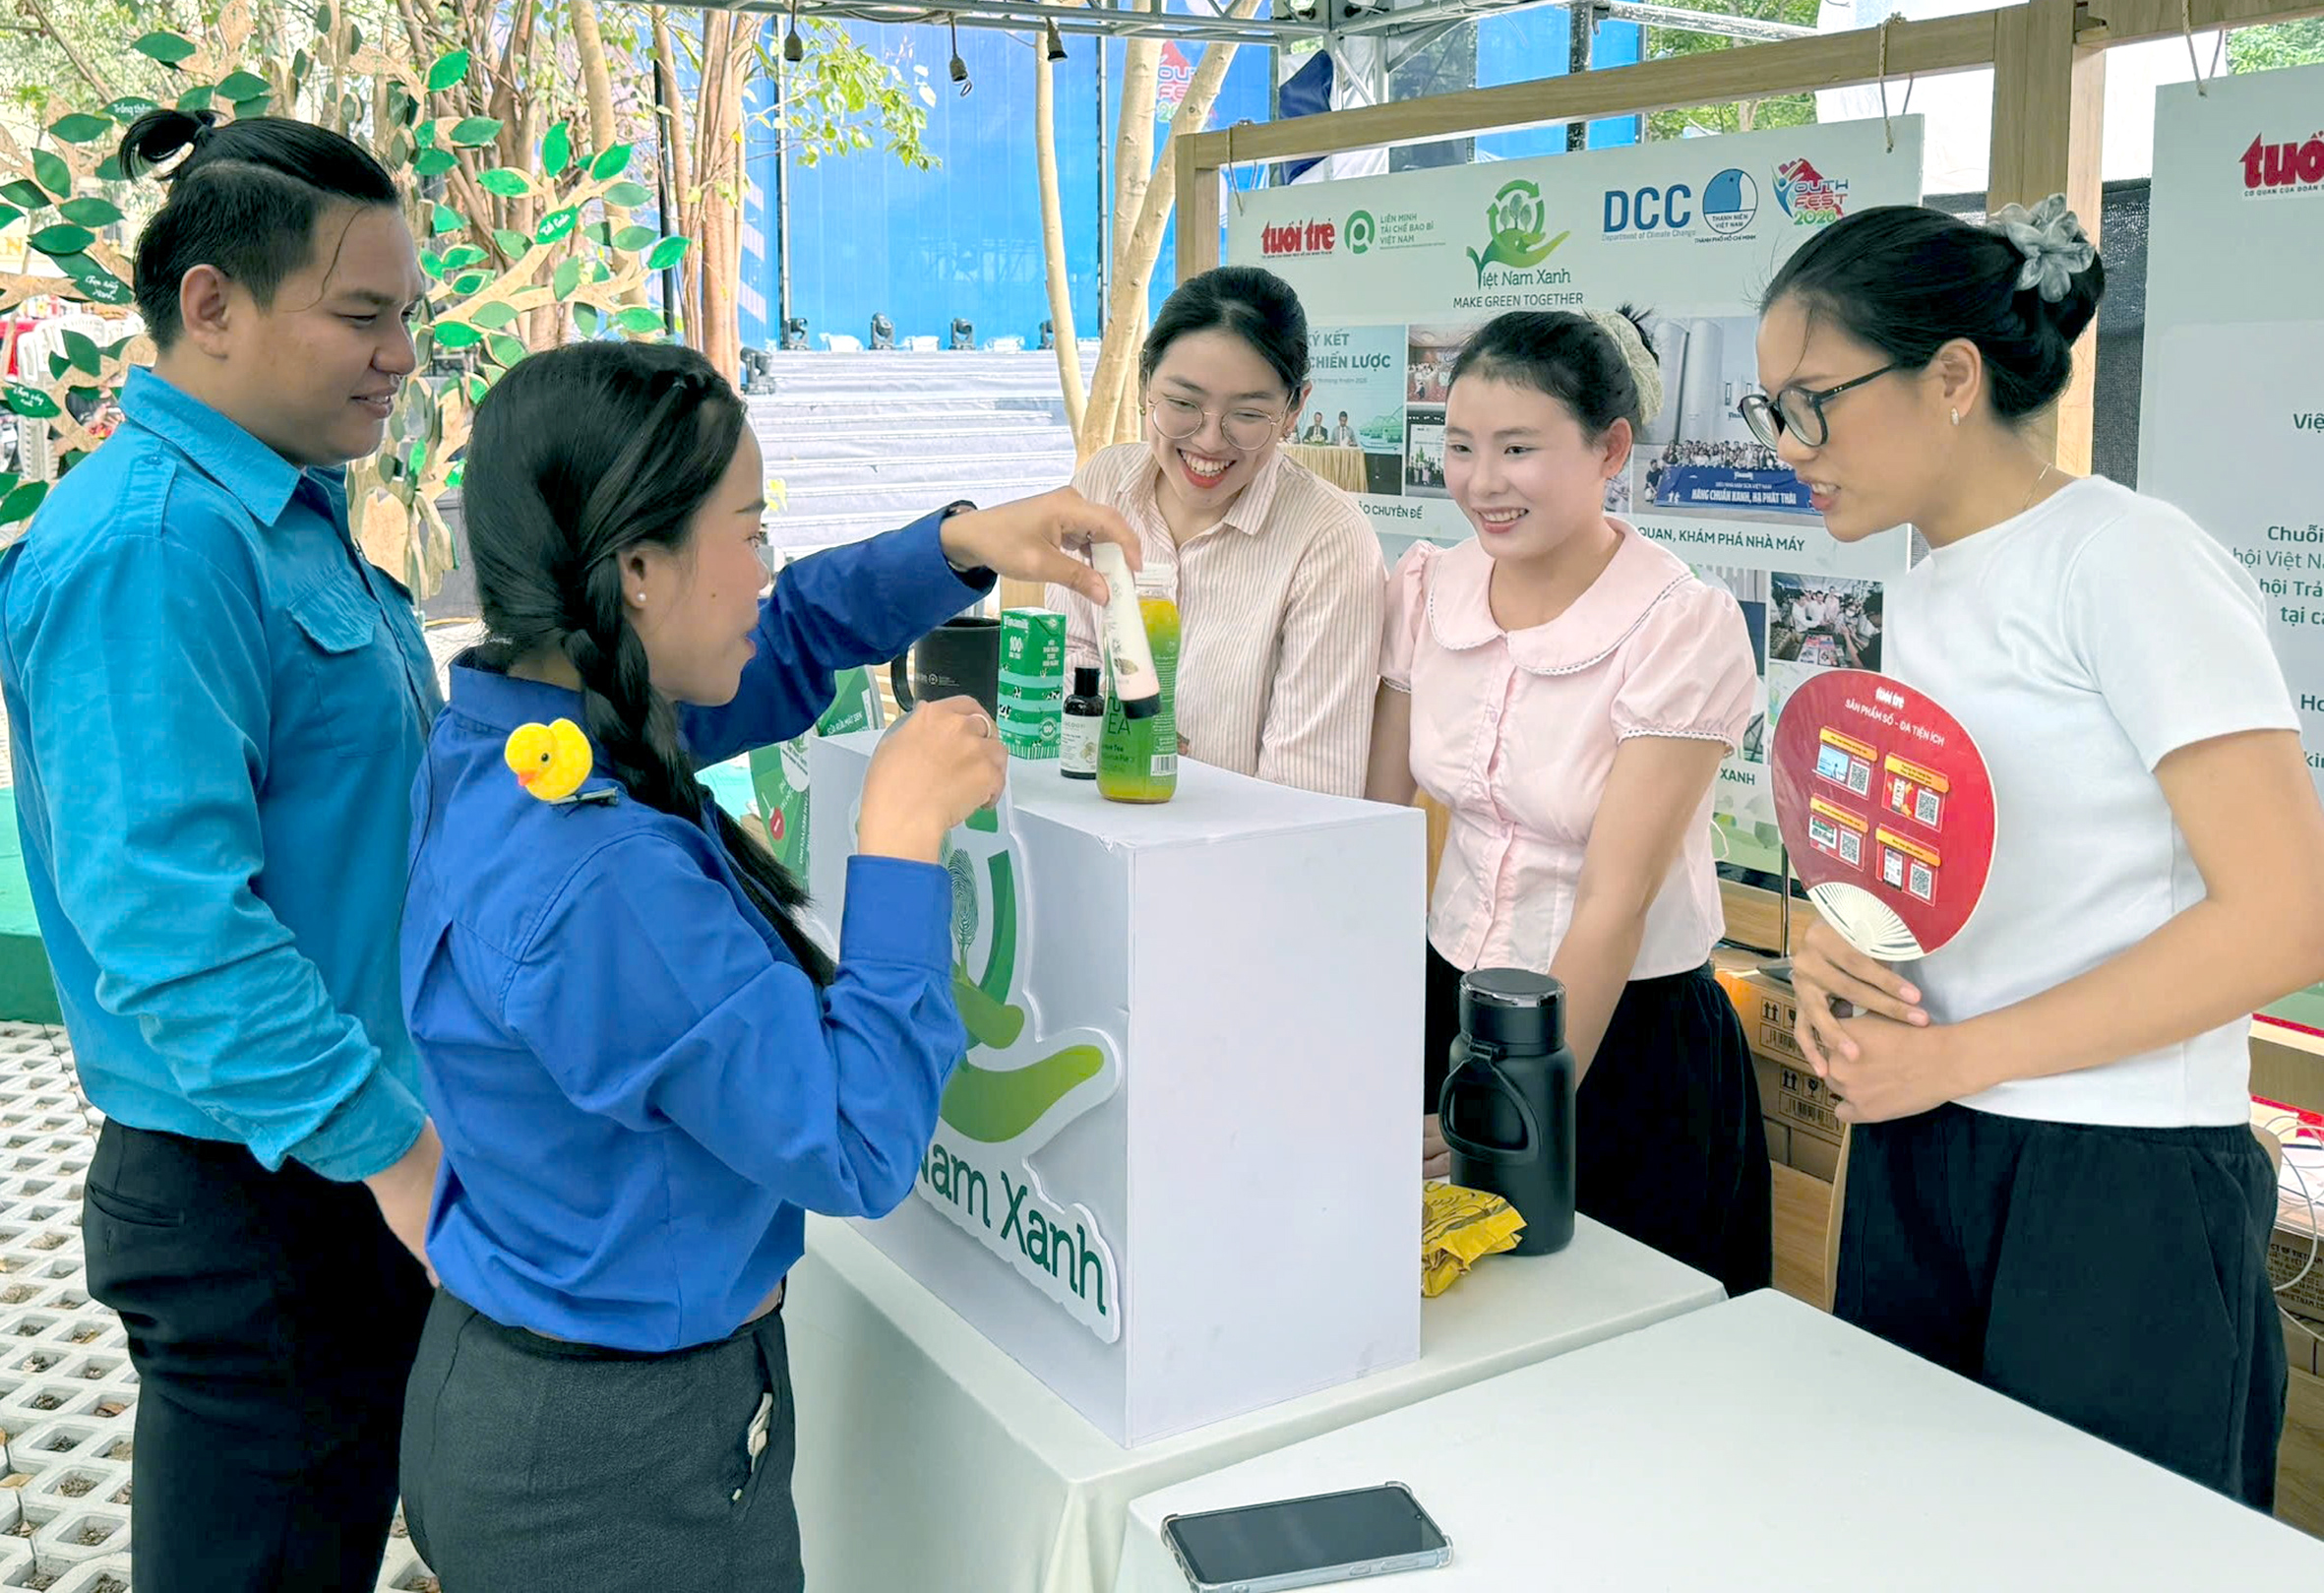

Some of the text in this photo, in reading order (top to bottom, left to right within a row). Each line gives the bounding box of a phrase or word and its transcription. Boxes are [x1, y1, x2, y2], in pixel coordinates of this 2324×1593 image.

[1604, 184, 1691, 232] DCC
[1795, 193, 1848, 208] FEST
[1380, 214, 1417, 223] LIÊN MINH
[1409, 223, 1425, 232] BAO
[1602, 232, 1637, 242] Department
[1647, 230, 1671, 239] Climate
[1673, 229, 1696, 238] Change
[1379, 234, 1414, 245] VIỆT NAM
[1501, 271, 1533, 285] Nam
[1537, 268, 1571, 284] Xanh
[1453, 292, 1584, 308] MAKE GREEN TOGETHER
[1323, 329, 1350, 346] KẾT
[1352, 353, 1391, 372] LƯỢC
[1372, 505, 1408, 518] CHUYÊN
[1679, 528, 1715, 544] KHÁM
[1718, 531, 1743, 547] PHÁ
[1746, 533, 1774, 549] NHÀ
[1776, 536, 1805, 551] MÁY
[2267, 524, 2324, 543] Chuỗi
[2233, 547, 2324, 571] hội Việt N
[2259, 579, 2287, 597] hội
[2281, 606, 2304, 627] tại
[1720, 767, 1755, 785] XANH
[1000, 1170, 1106, 1317] Xanh
